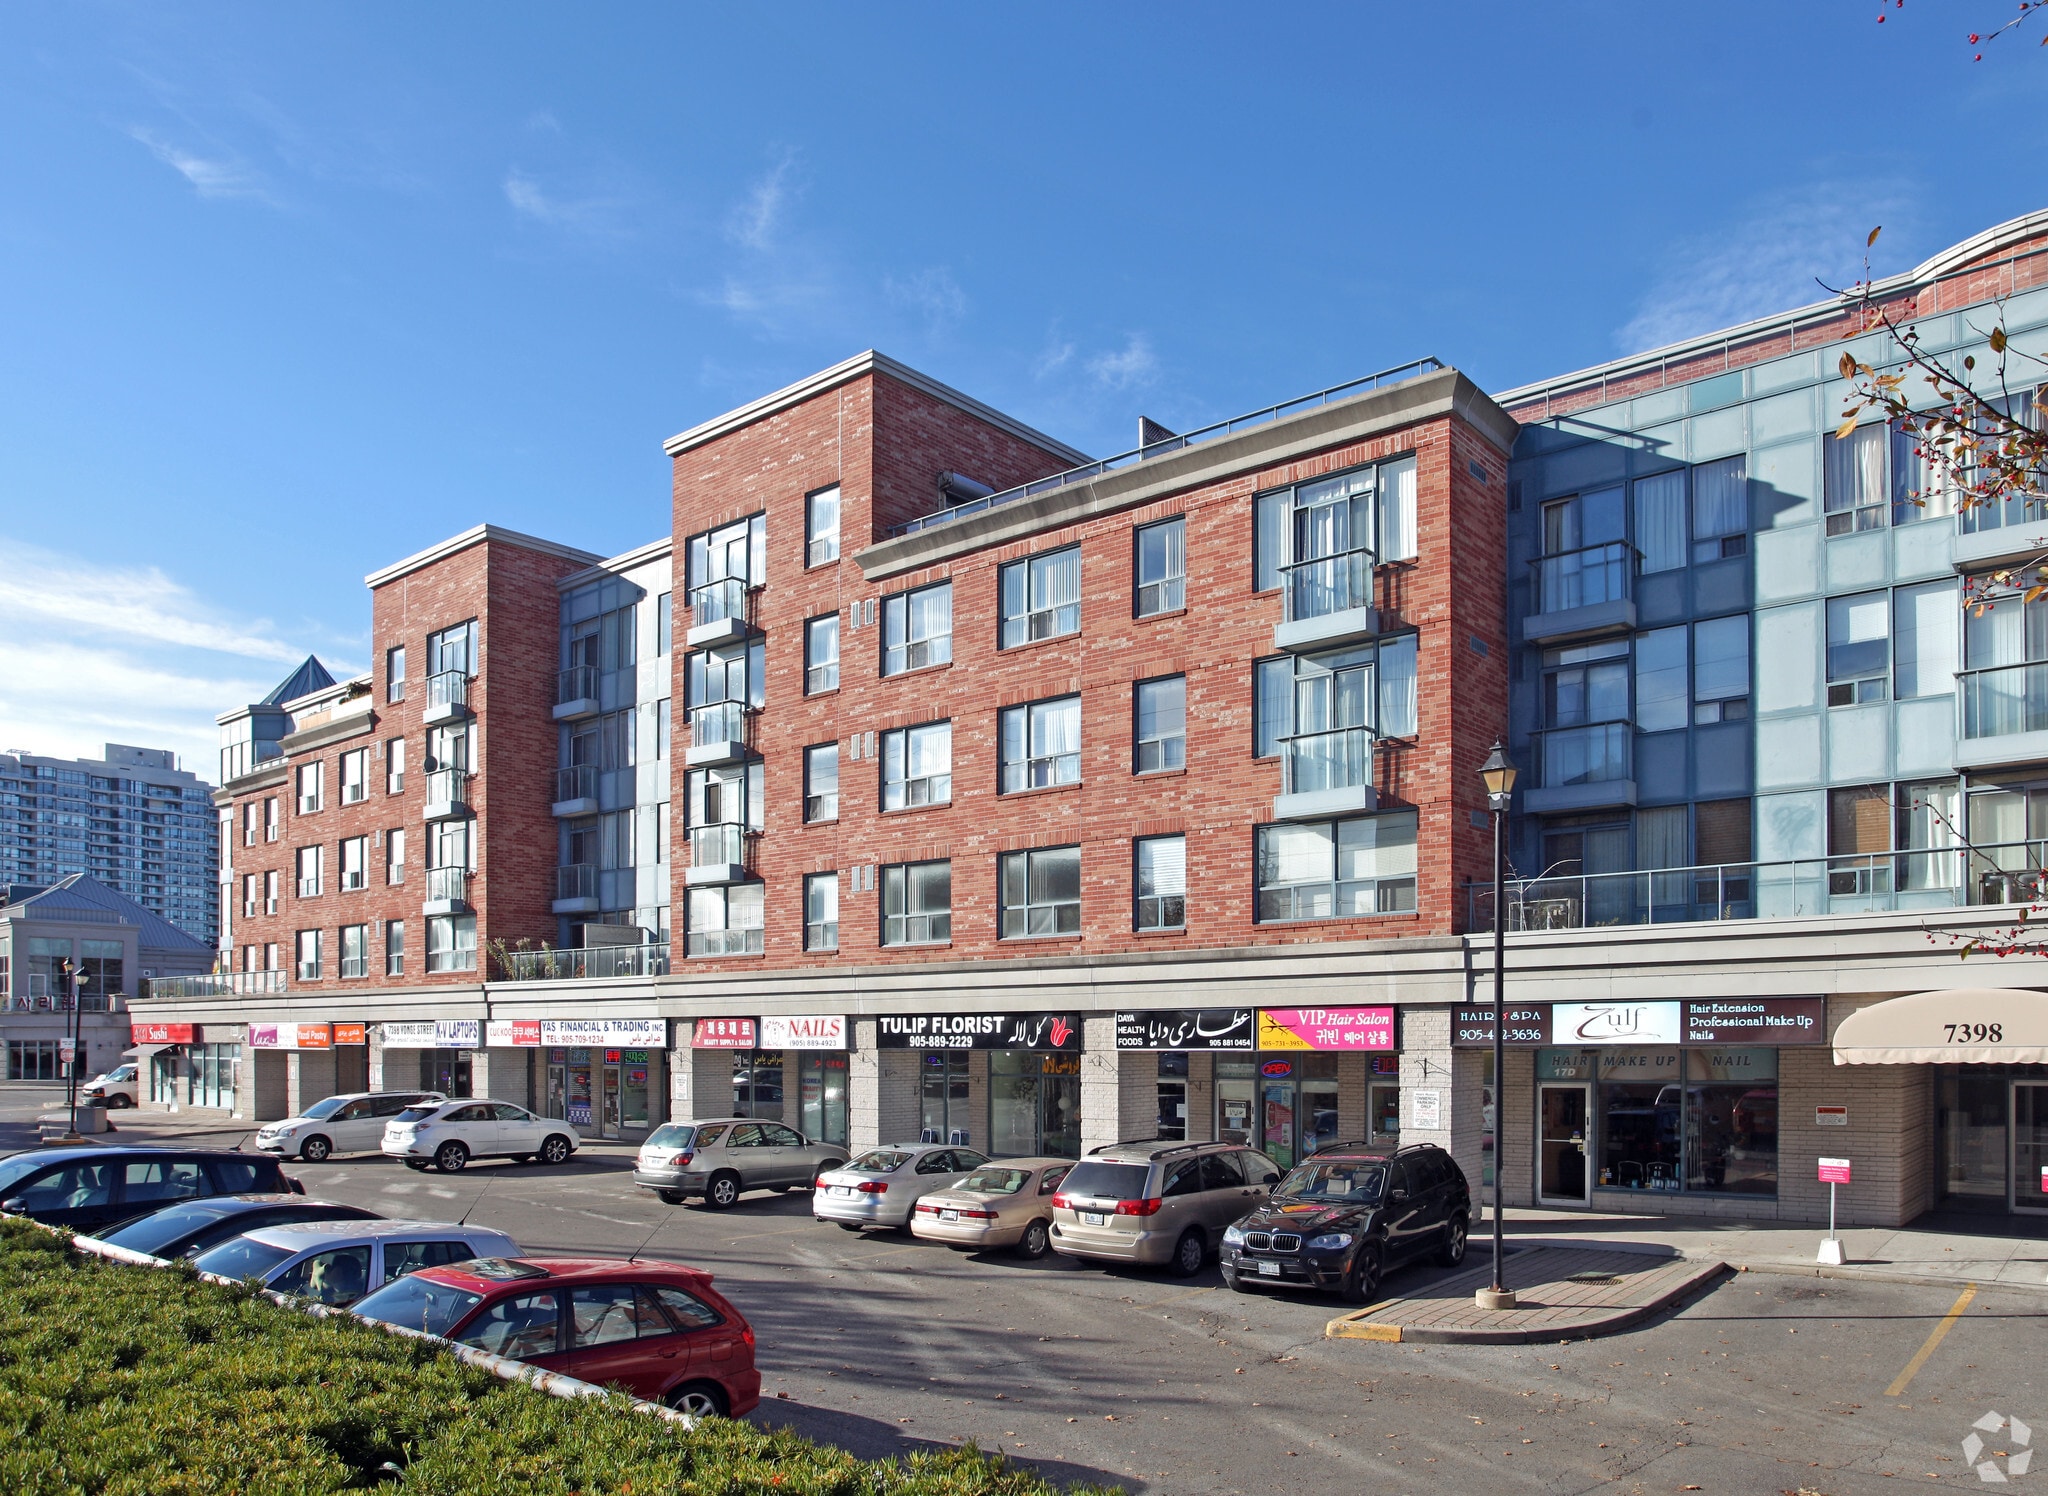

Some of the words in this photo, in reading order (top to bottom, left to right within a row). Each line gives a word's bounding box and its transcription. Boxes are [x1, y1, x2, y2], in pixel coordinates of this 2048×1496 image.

[1690, 1004, 1711, 1014] Hair
[1712, 1003, 1765, 1014] Extension
[1118, 1014, 1135, 1022] DAYA
[1297, 1010, 1327, 1026] VIP
[1326, 1013, 1354, 1026] Hair
[1355, 1012, 1390, 1026] Salon
[1460, 1012, 1495, 1021] HAIR
[1690, 1016, 1763, 1027] Professional
[1766, 1016, 1795, 1026] Make
[1796, 1015, 1814, 1029] Up
[388, 1025, 400, 1035] 7398
[400, 1025, 416, 1035] YONGE
[417, 1024, 435, 1035] STREET
[449, 1022, 478, 1038] LAPTOPS
[542, 1022, 556, 1032] YAS
[560, 1022, 601, 1032] FINANCIAL
[604, 1022, 610, 1032] &
[612, 1021, 650, 1032] TRADING
[787, 1017, 842, 1038] NAILS
[880, 1017, 928, 1034] TULIP
[932, 1016, 1005, 1034] FLORIST
[1118, 1026, 1146, 1034] HEALTH
[149, 1027, 168, 1040] Sushi
[310, 1030, 328, 1042] Pastry
[490, 1028, 512, 1036] CUCKOO
[1316, 1029, 1339, 1045] 귀빈
[1344, 1031, 1364, 1044] 헤어
[1366, 1030, 1389, 1045] 살롱
[1460, 1029, 1542, 1041] 905-42-3636
[1690, 1030, 1714, 1040] Nails
[1943, 1023, 2003, 1044] 7398
[546, 1035, 560, 1044] TEL:
[561, 1034, 604, 1044] 905-709-1234
[704, 1038, 718, 1046] BEAUTY
[720, 1038, 734, 1046] SUPPLY
[738, 1038, 752, 1046] SALON
[910, 1035, 973, 1048] 905-889-2229
[1118, 1038, 1143, 1046] FOODS
[1377, 1057, 1399, 1073] OPE
[1552, 1056, 1588, 1066] HAIR
[1603, 1056, 1648, 1066] MAKE
[1655, 1056, 1676, 1066] UP
[1712, 1056, 1752, 1066] NAIL
[1262, 1062, 1291, 1075] OPEN
[1554, 1068, 1576, 1077] 17D
